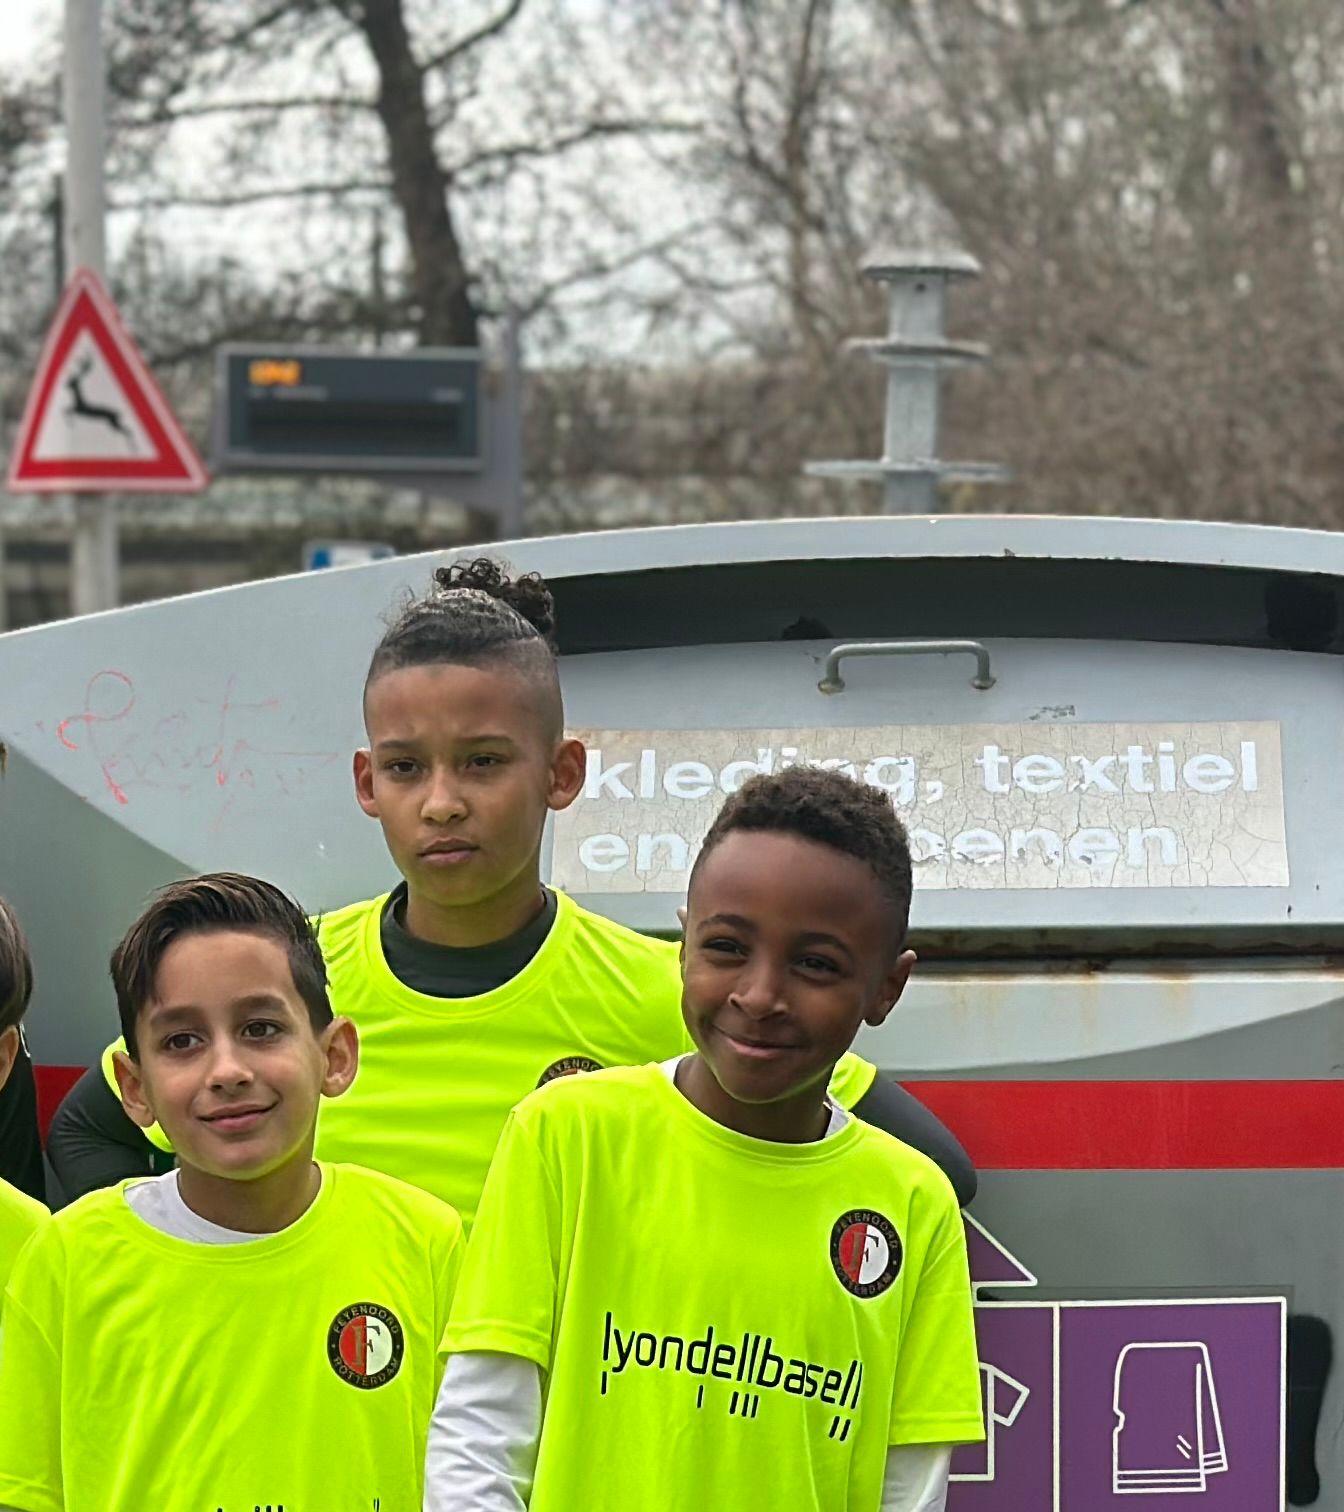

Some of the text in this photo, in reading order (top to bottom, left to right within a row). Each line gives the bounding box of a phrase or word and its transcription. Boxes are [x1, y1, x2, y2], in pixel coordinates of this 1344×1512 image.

[975, 741, 1259, 796] textiel
[578, 827, 1181, 873] en oenen
[333, 1304, 400, 1335] FEYENOORD
[352, 1325, 381, 1367] F
[602, 1311, 863, 1411] lyondellbasell
[332, 1355, 399, 1387] ROTTERDAM
